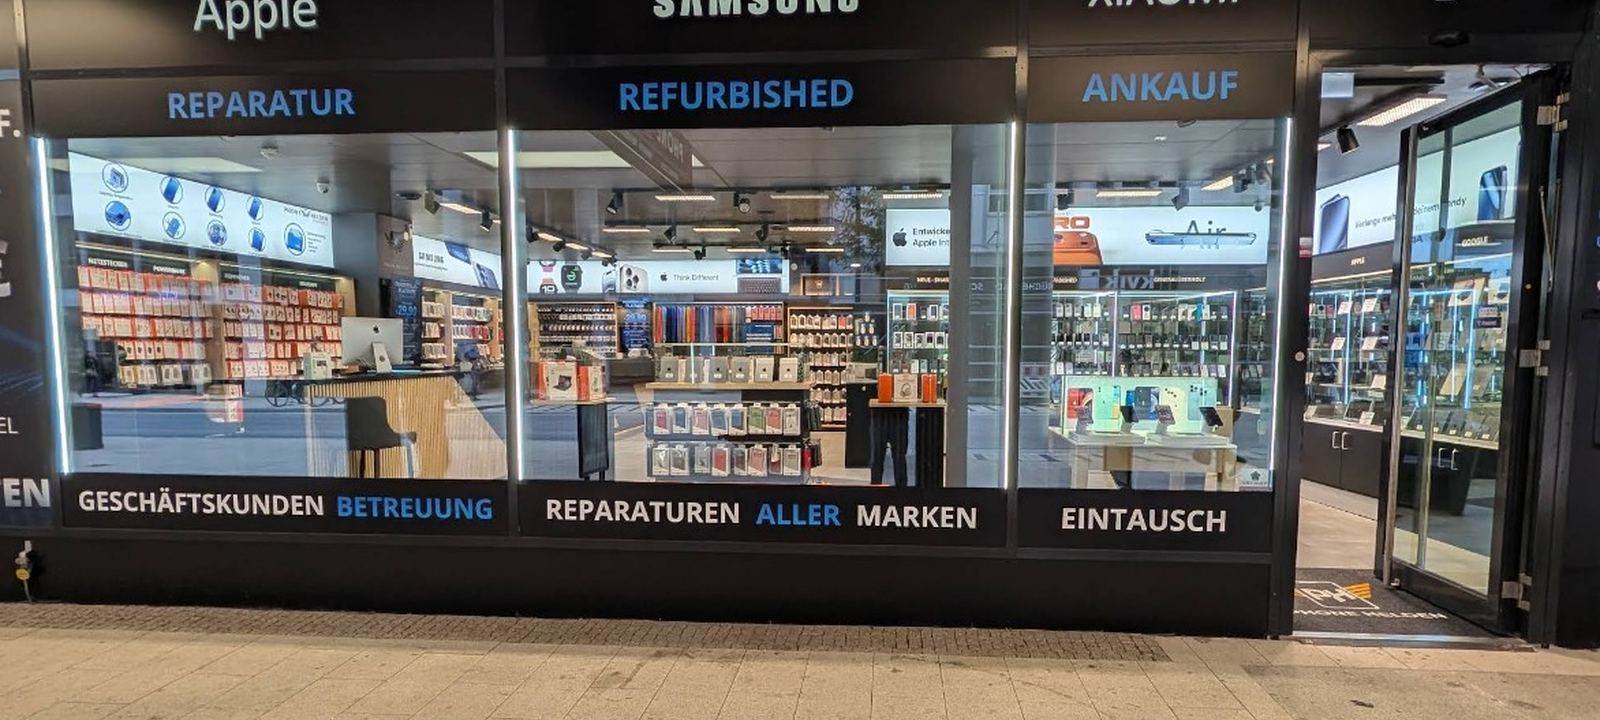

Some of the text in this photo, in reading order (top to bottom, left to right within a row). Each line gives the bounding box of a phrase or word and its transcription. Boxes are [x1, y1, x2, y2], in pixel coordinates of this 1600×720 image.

[193, 0, 318, 40] Apple
[619, 79, 854, 111] REFURBISHED
[1082, 70, 1239, 103] ANKAUF
[167, 88, 356, 119] REPARATUR
[912, 239, 937, 248] Apple
[0, 478, 51, 508] EN
[78, 486, 493, 520] GESCHÄFTSKUNDEN BETREUUNG
[546, 498, 978, 529] REPARATUREN ALLER MARKEN
[1061, 507, 1227, 532] EINTAUSCH
